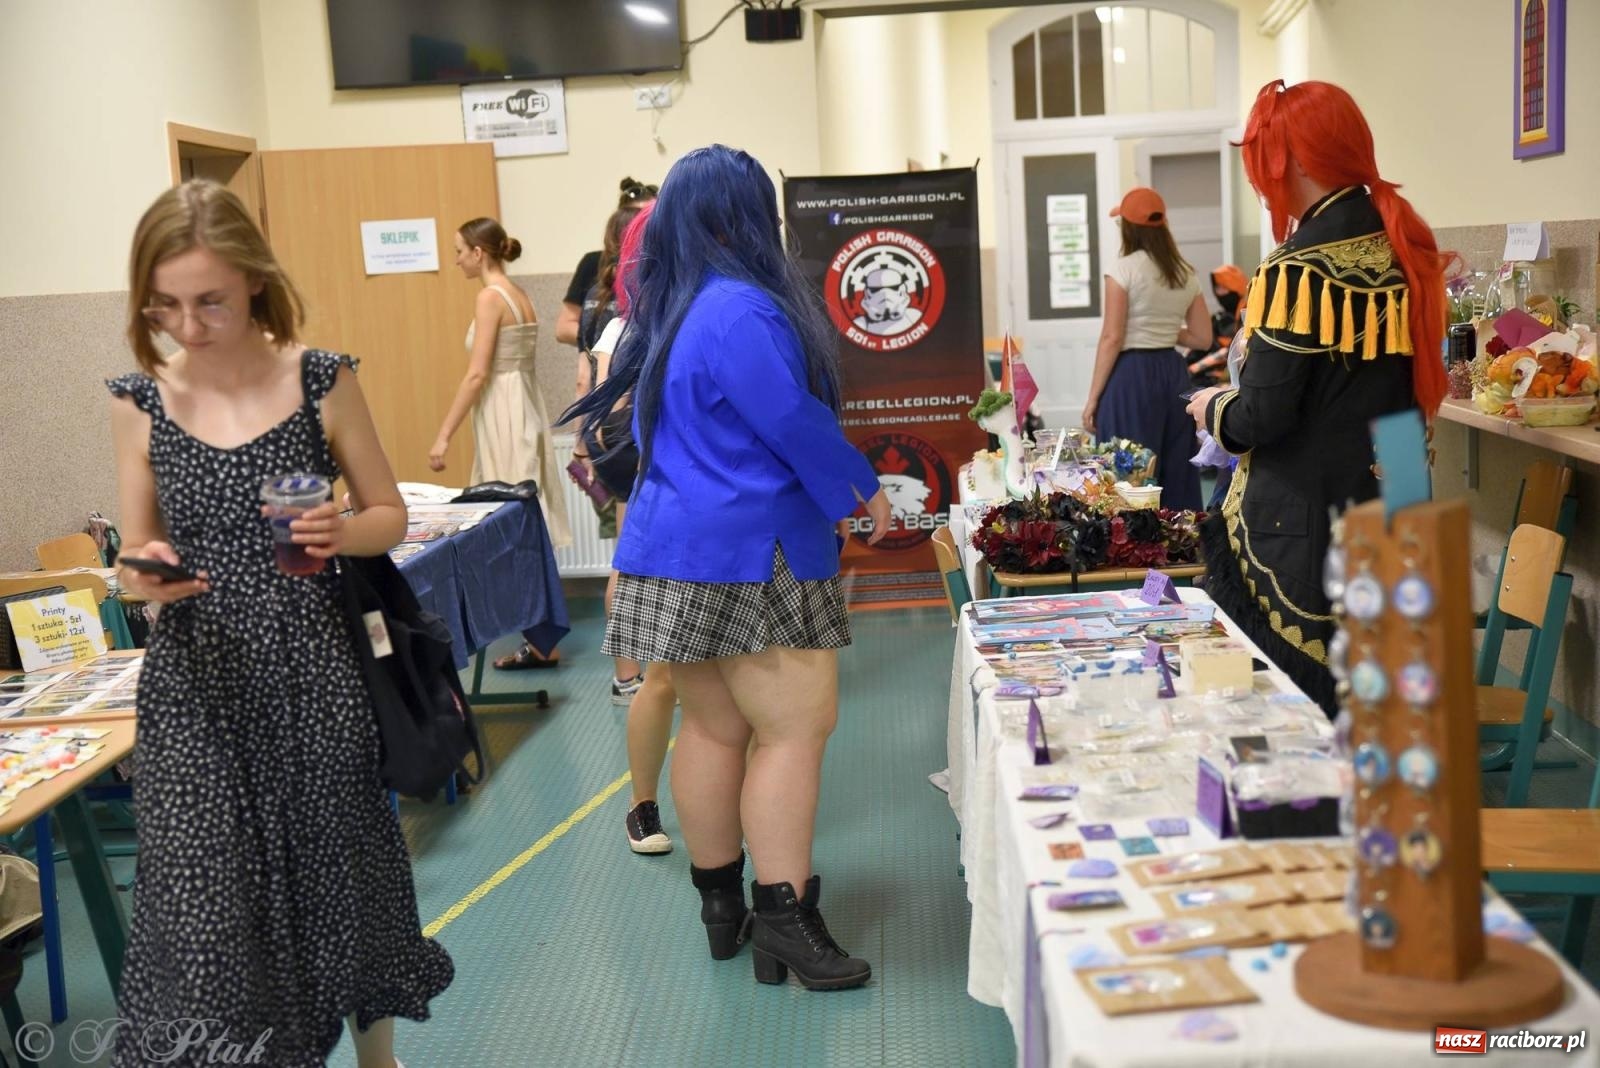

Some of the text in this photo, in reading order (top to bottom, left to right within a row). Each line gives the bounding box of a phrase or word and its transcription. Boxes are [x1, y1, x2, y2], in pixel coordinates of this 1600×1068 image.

[797, 192, 965, 208] WWW.POLISH-GARRISON.PL
[380, 230, 419, 245] SKLEPIK
[832, 231, 936, 272] POLISH GARRISON
[882, 322, 928, 350] LEGION
[41, 607, 66, 617] Printy
[31, 623, 36, 631] 1
[37, 619, 63, 630] sztuka
[34, 635, 41, 644] 3
